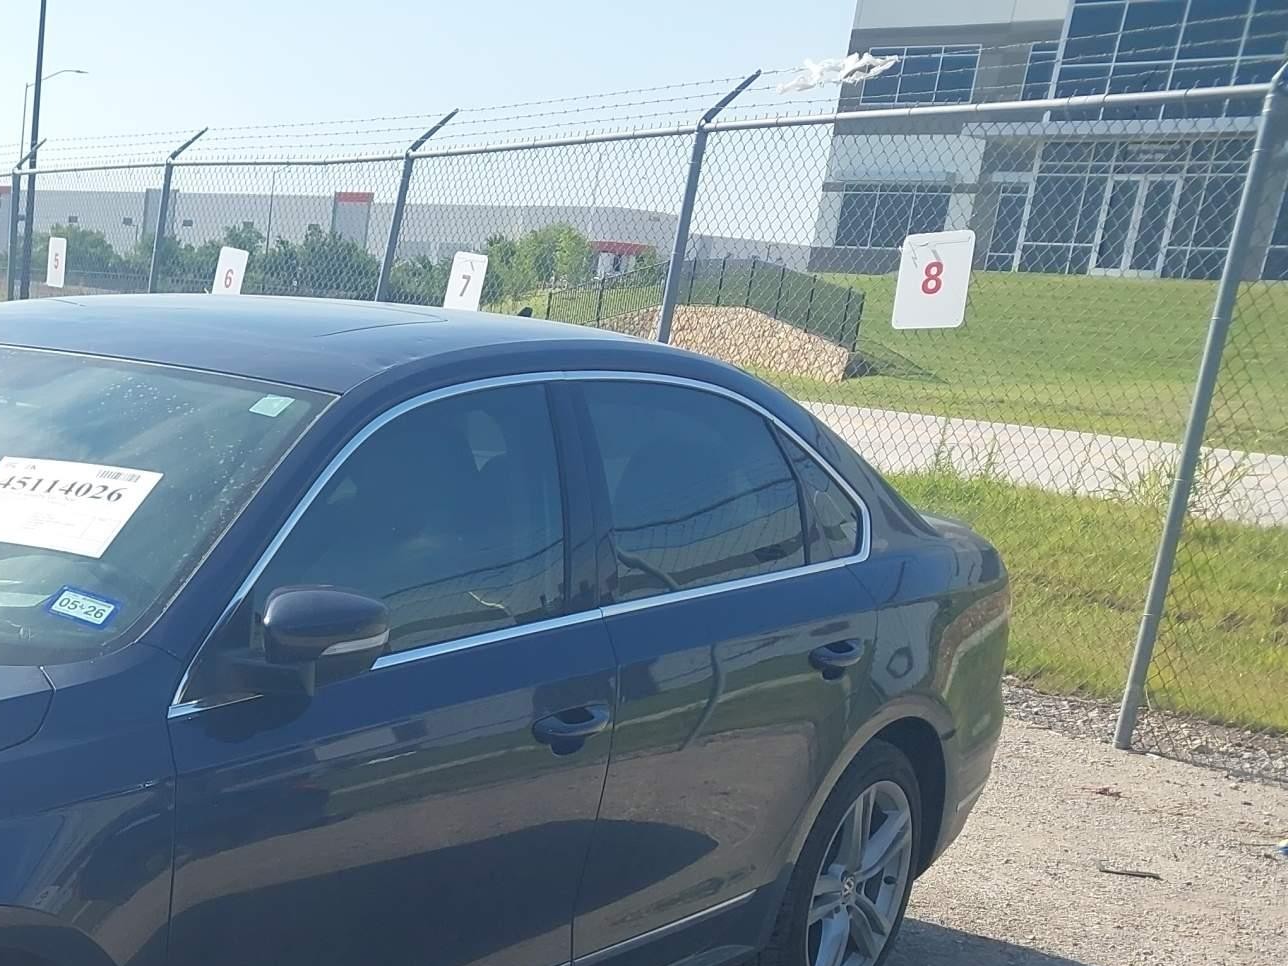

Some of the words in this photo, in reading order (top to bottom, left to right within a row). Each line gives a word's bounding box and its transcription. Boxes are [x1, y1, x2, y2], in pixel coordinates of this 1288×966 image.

[54, 253, 60, 270] 5
[224, 268, 234, 289] 6
[460, 274, 472, 297] 7
[921, 261, 944, 295] 8
[58, 597, 81, 611] 05
[83, 605, 106, 619] 26
